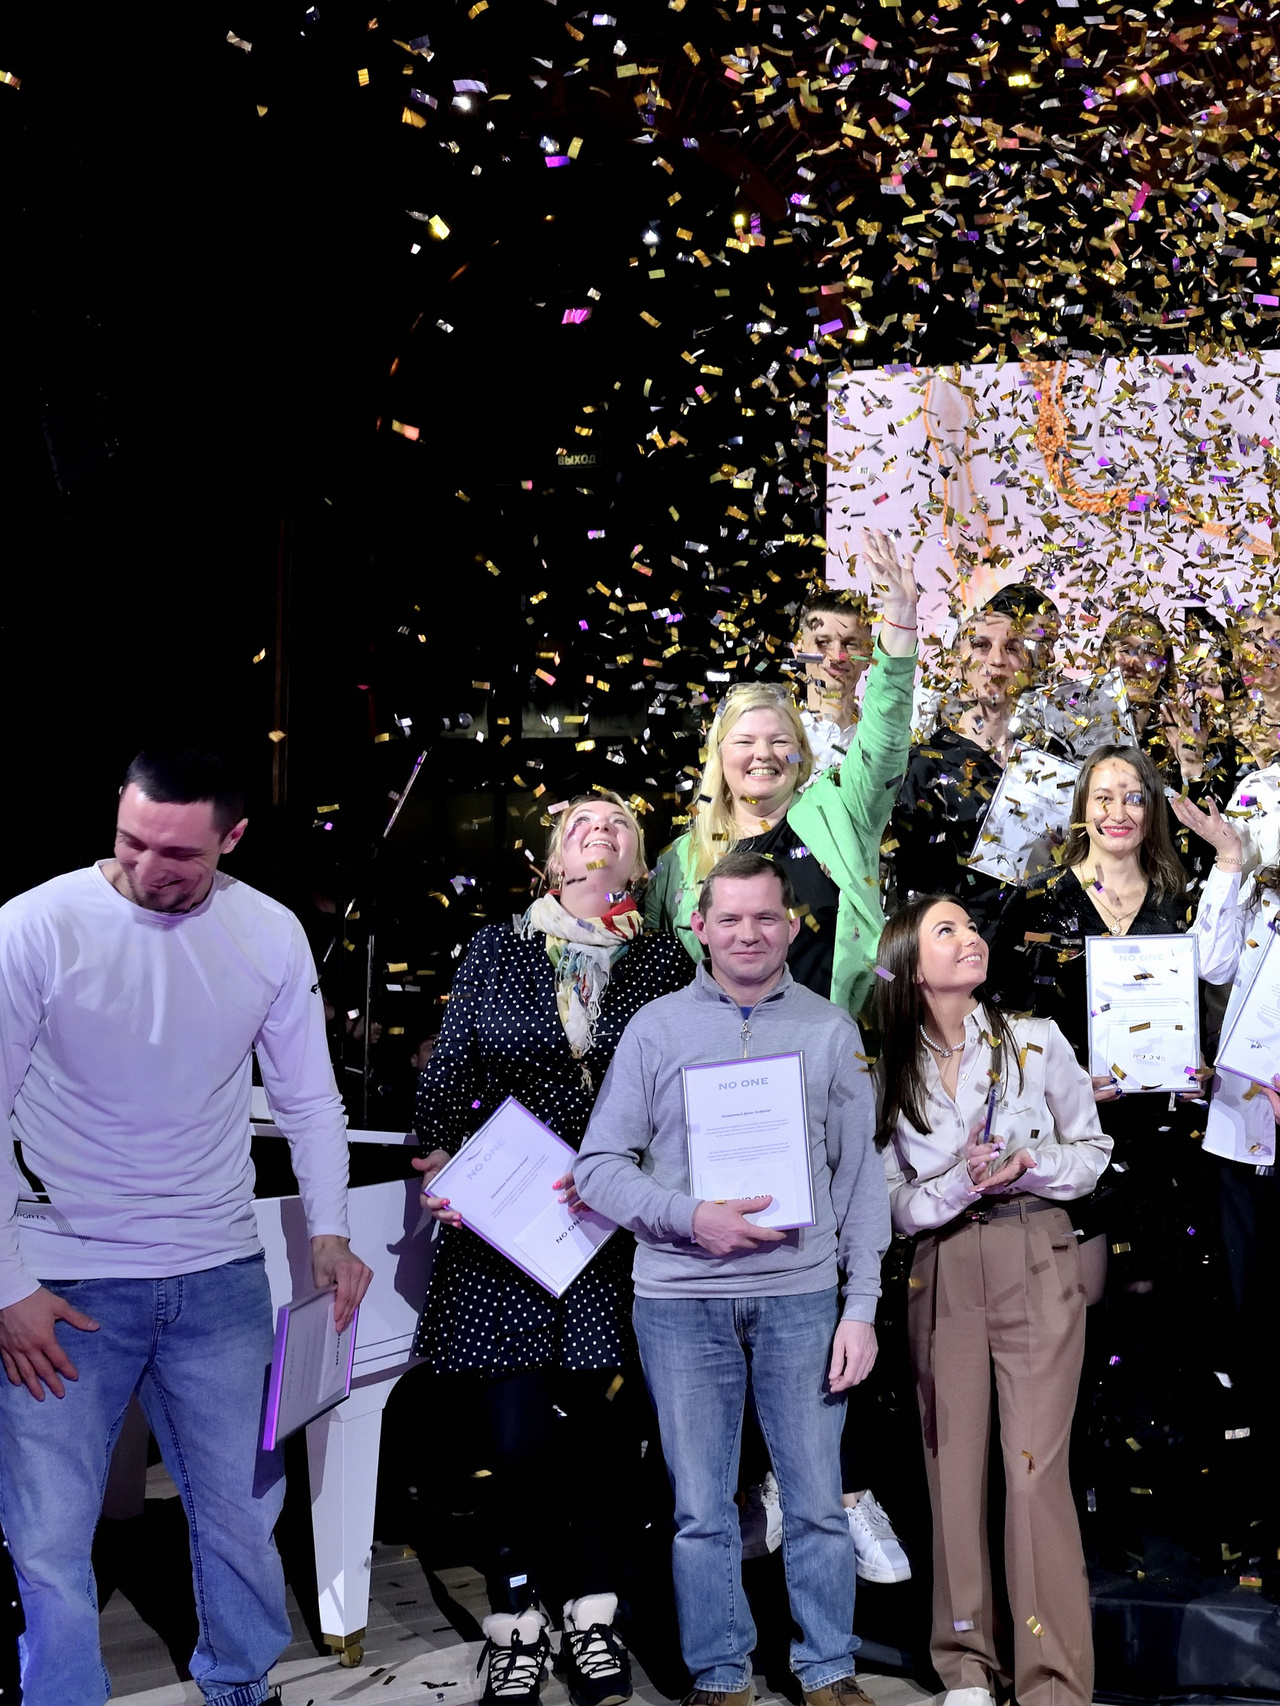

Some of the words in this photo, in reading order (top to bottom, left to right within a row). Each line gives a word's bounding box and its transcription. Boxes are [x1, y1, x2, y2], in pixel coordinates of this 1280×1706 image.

[558, 454, 597, 466] ВЫХОД
[1020, 824, 1031, 832] NO
[1032, 830, 1047, 840] ONE
[1119, 954, 1136, 962] NO
[1139, 953, 1164, 962] ONE
[718, 1080, 737, 1091] NO
[740, 1077, 769, 1089] ONE
[467, 1163, 483, 1180] NO
[484, 1139, 506, 1162] ONE
[556, 1232, 568, 1243] NO
[568, 1216, 585, 1231] ONE
